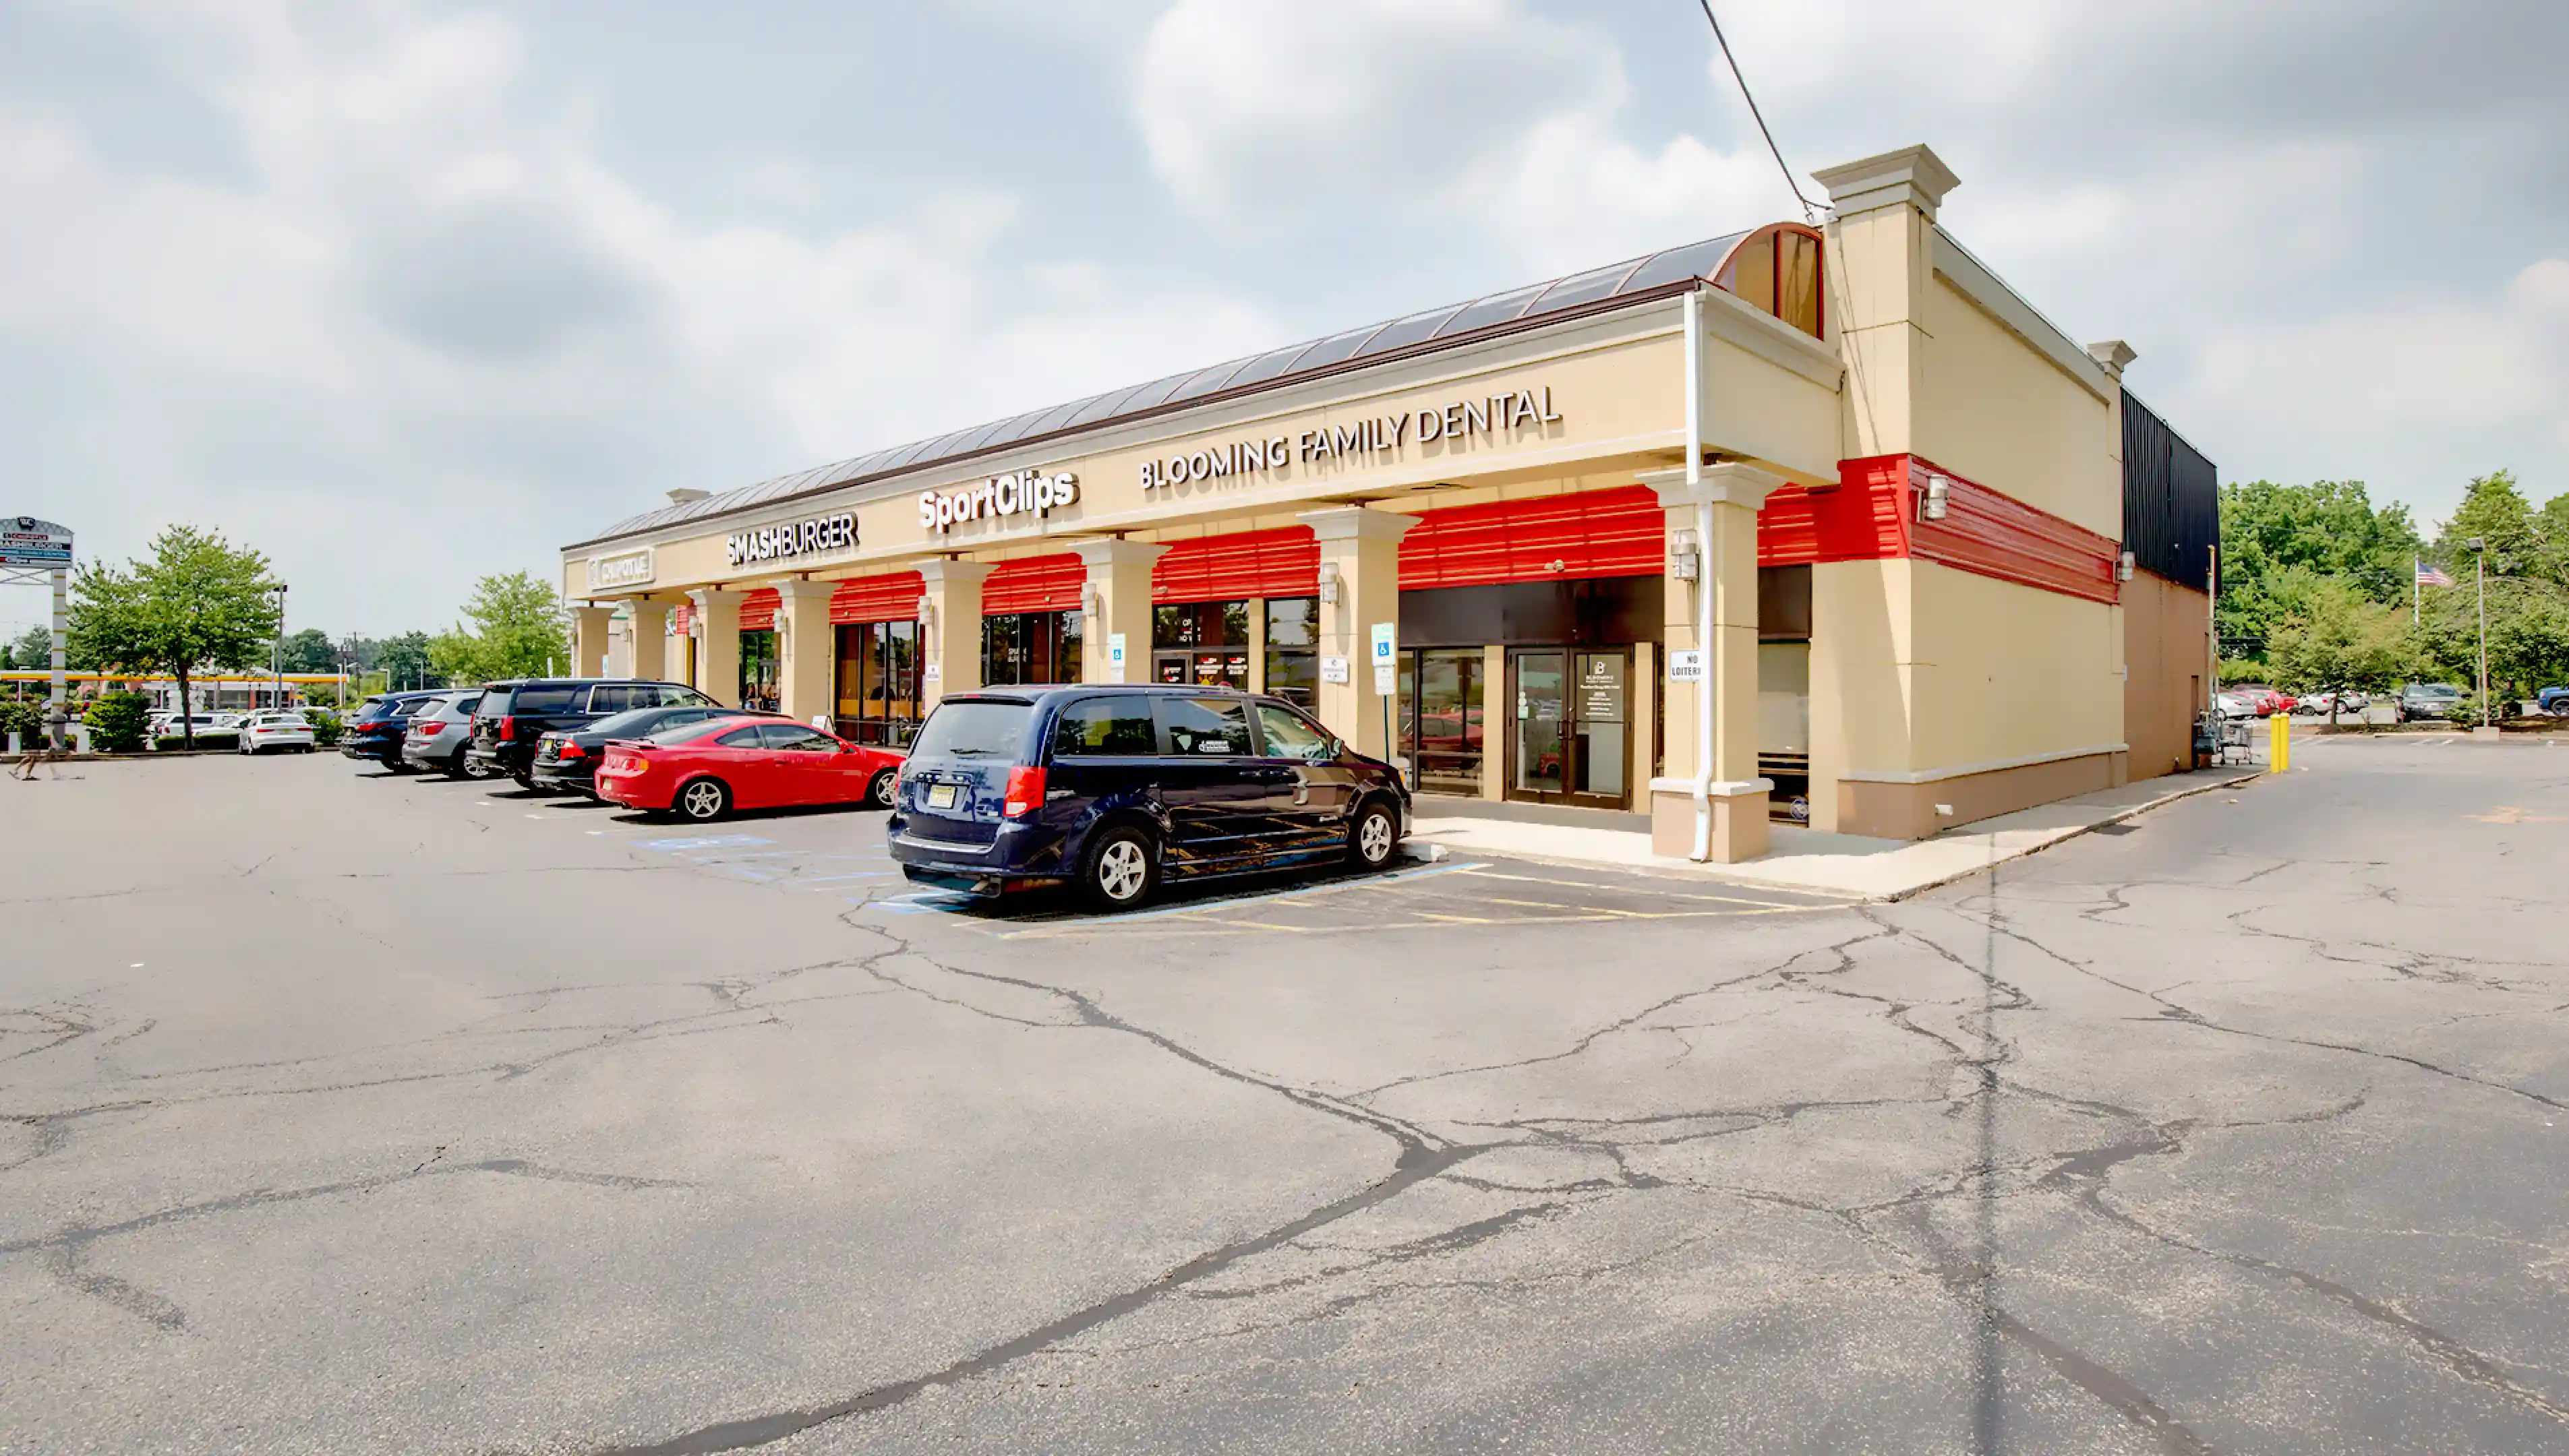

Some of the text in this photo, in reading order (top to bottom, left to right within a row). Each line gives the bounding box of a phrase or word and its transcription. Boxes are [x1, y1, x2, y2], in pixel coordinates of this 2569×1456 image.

[1140, 386, 1563, 489] BLOOMING FAMILY DENTAL
[919, 470, 1081, 534] SportClips
[726, 511, 860, 566] SMASHBURGER
[1686, 655, 1699, 664] NO
